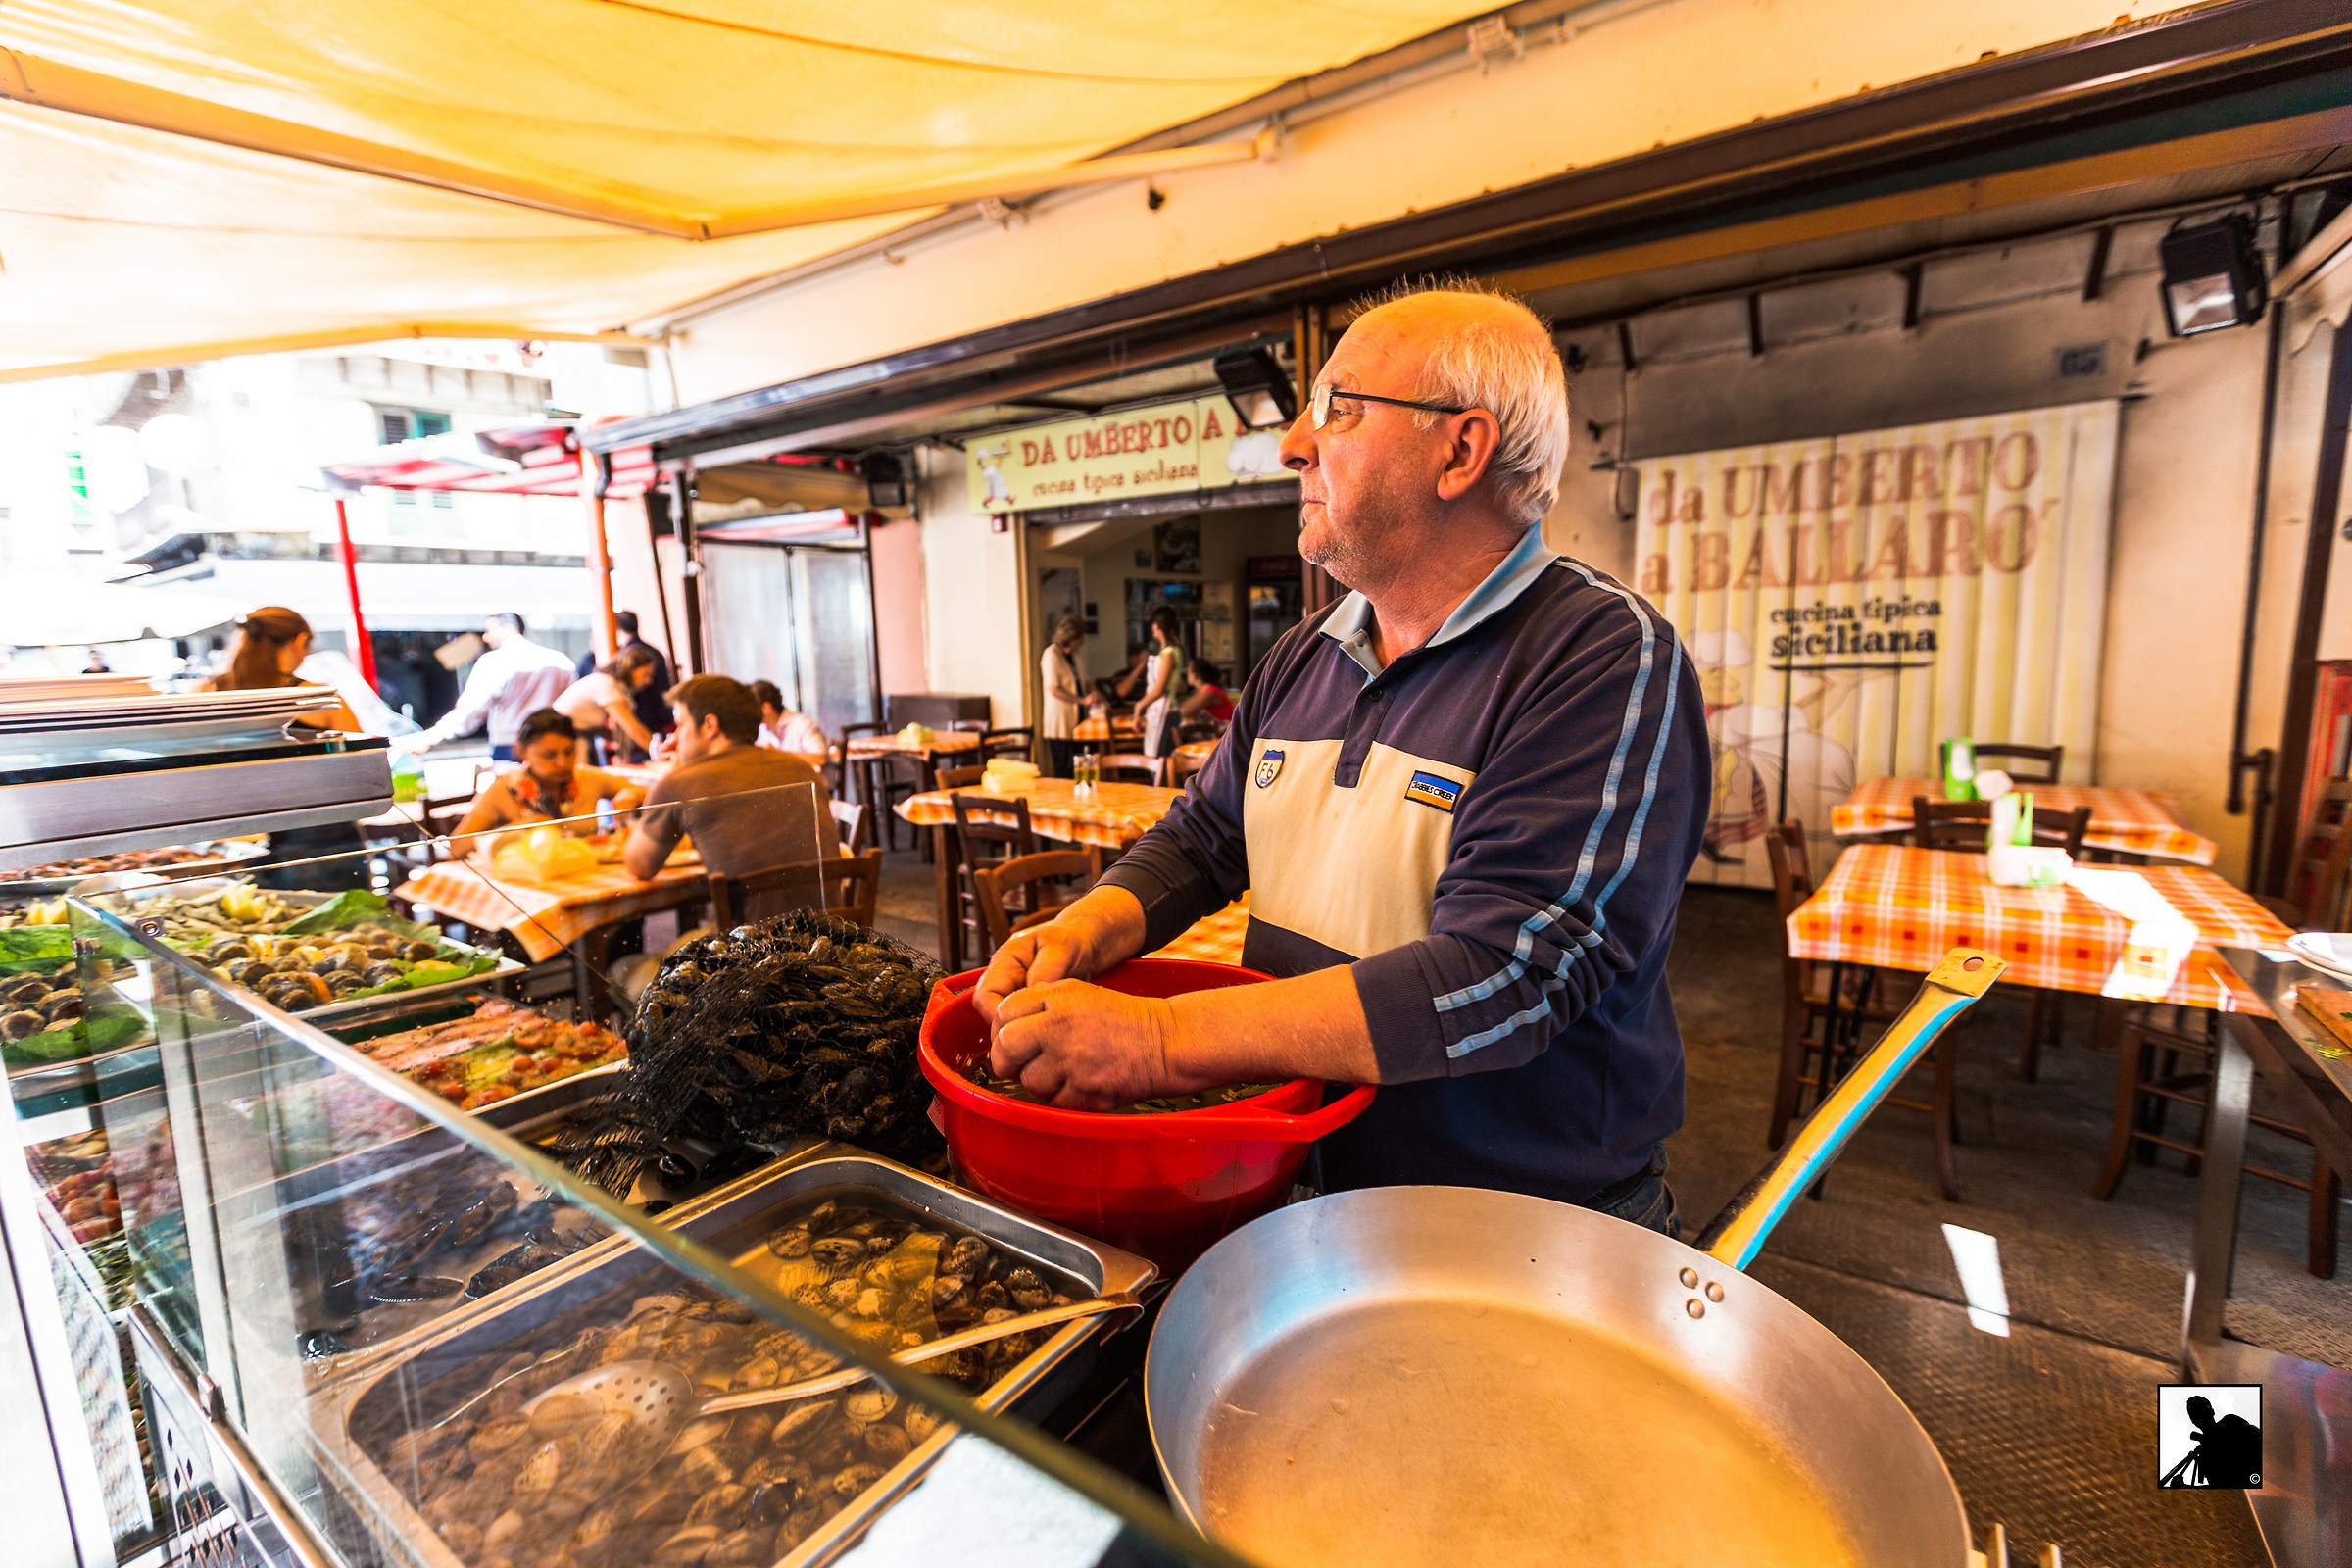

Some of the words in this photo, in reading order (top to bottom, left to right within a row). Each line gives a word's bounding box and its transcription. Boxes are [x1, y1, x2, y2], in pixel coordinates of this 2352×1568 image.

[1021, 435, 1056, 466] DA
[1066, 415, 1192, 461] UMBERTO
[1201, 408, 1223, 439] A
[1649, 469, 1705, 526] da
[1720, 430, 2039, 518] UMBERTO
[1641, 552, 1672, 596] a
[1771, 601, 1854, 623] cucina
[1864, 595, 1941, 623] tipica
[1771, 622, 1937, 658] siciliana
